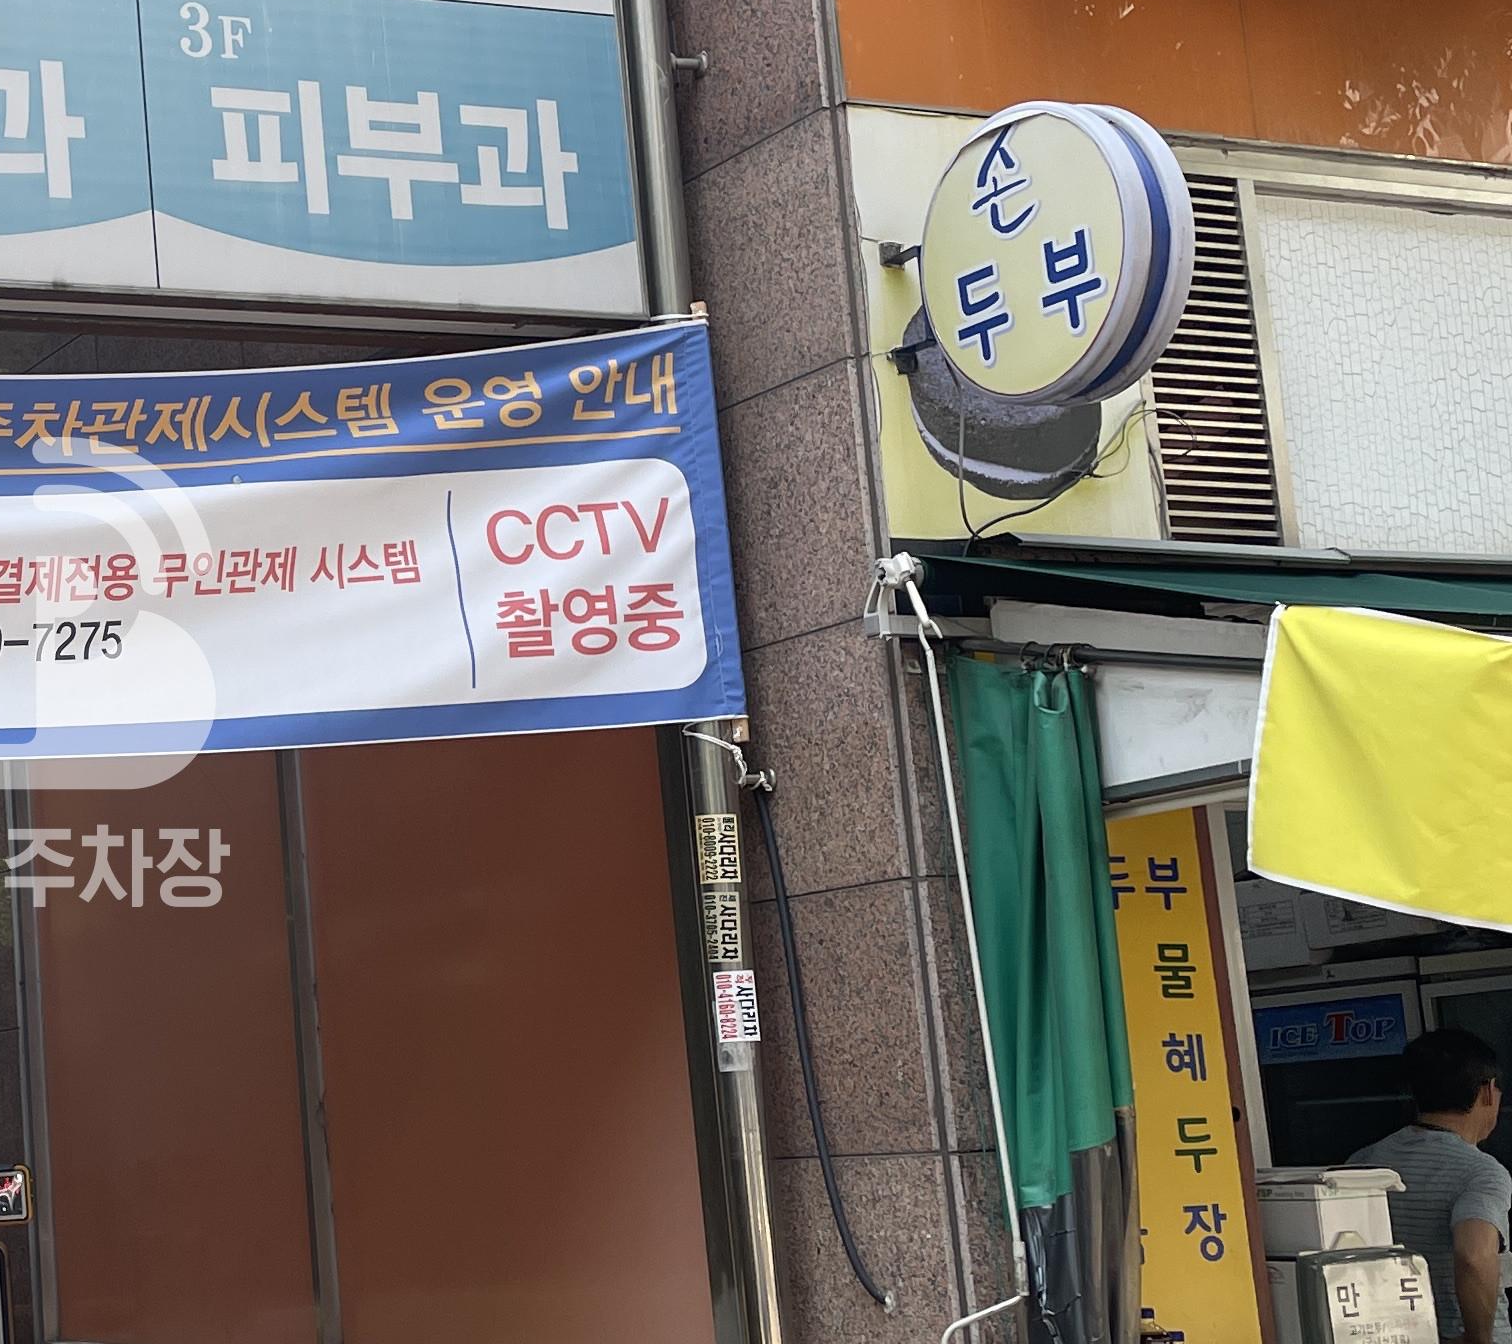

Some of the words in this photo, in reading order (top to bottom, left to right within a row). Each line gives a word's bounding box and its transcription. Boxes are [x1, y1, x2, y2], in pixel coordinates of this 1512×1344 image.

[179, 1, 252, 60] 3F
[211, 80, 578, 231] 피부과
[973, 126, 1036, 234] 손
[422, 371, 544, 429] 운영
[568, 352, 677, 422] 안내
[486, 498, 669, 566] CCTV
[152, 544, 296, 600] 무인관제
[310, 539, 421, 589] 시스템
[496, 582, 684, 659] 촬영중
[719, 905, 738, 960] 사다리차
[1270, 1023, 1319, 1049] ICE
